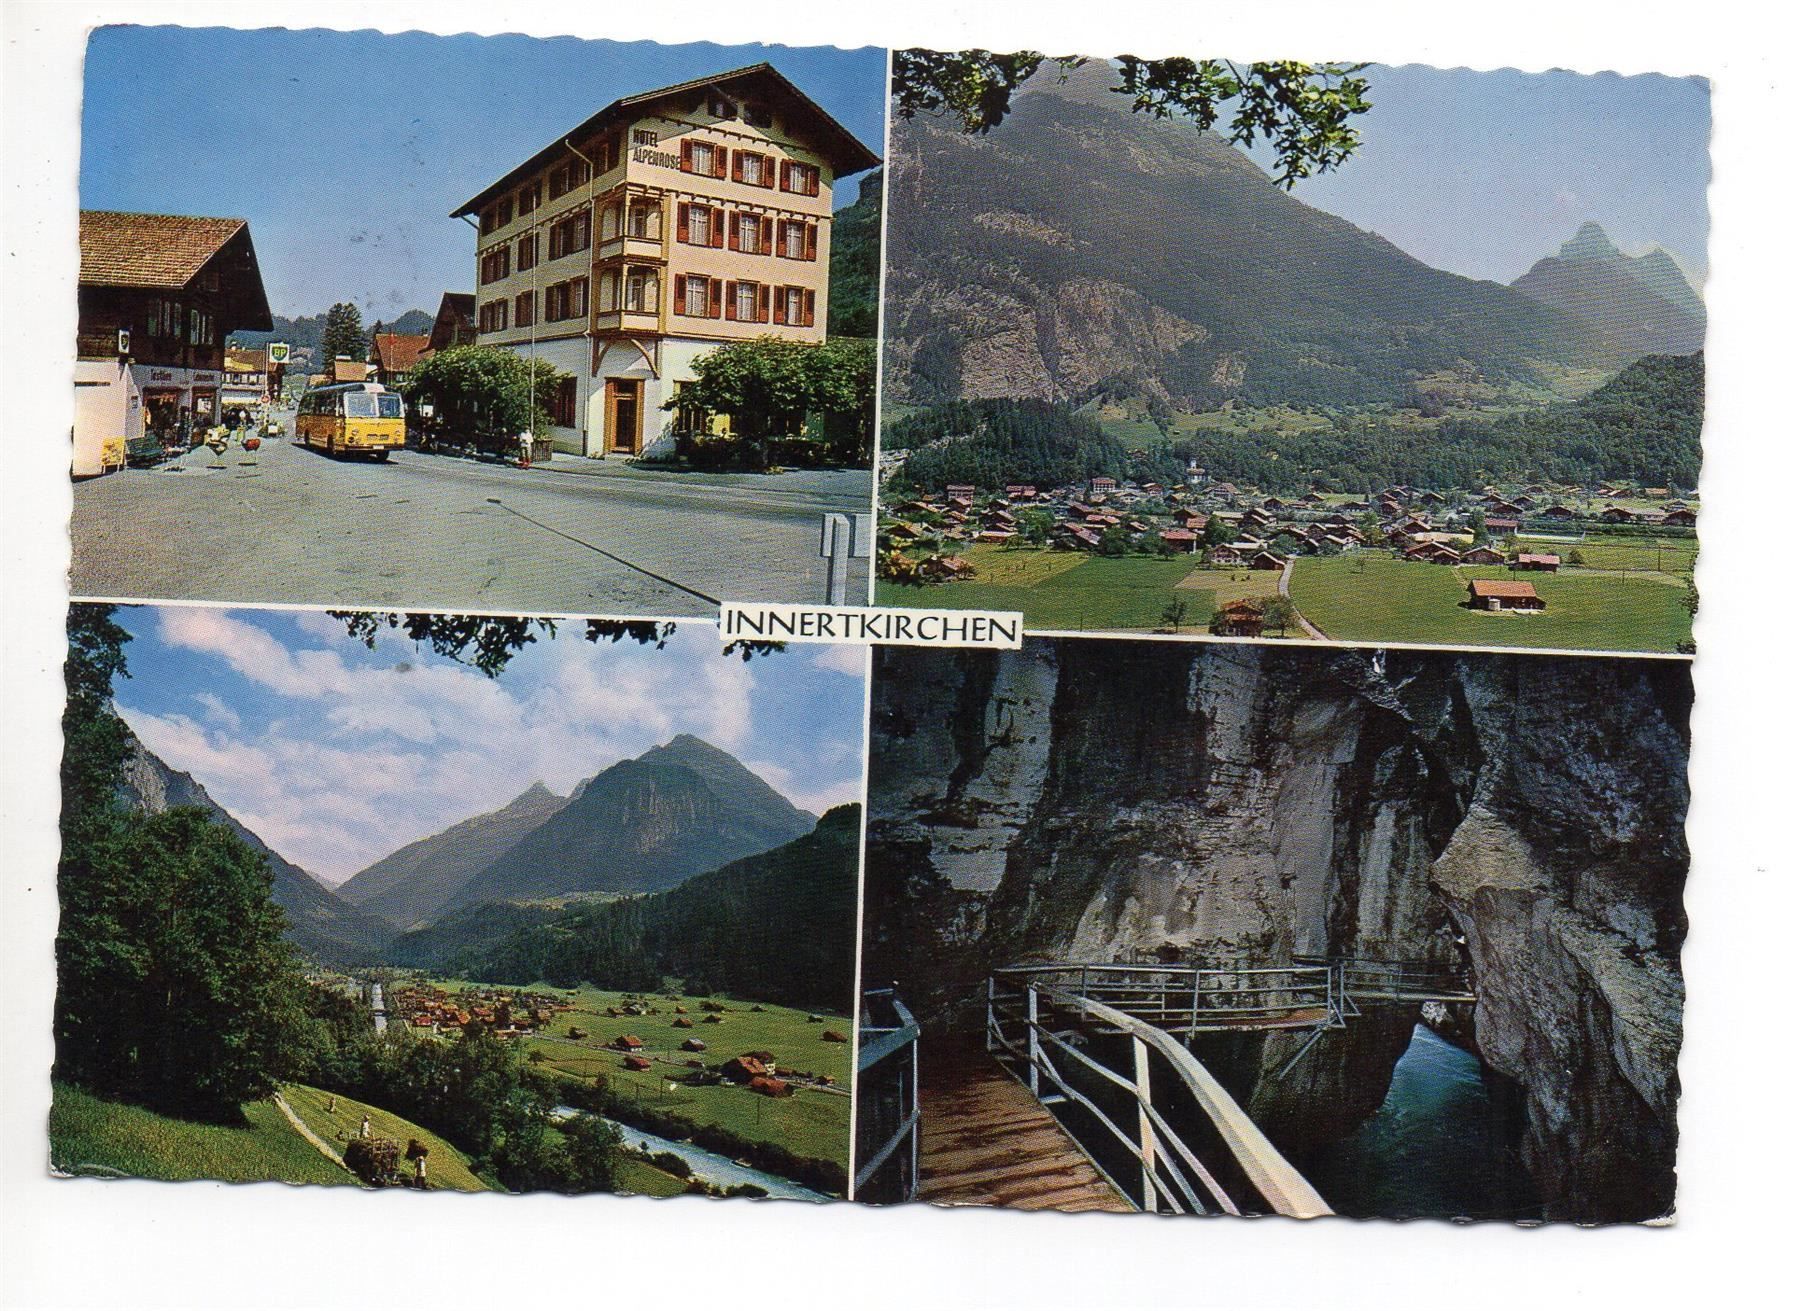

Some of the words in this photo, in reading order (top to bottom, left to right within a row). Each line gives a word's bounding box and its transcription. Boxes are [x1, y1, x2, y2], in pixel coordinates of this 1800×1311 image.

[633, 129, 658, 147] HOTEL
[633, 147, 681, 169] ALPENROSE
[274, 348, 287, 357] BP
